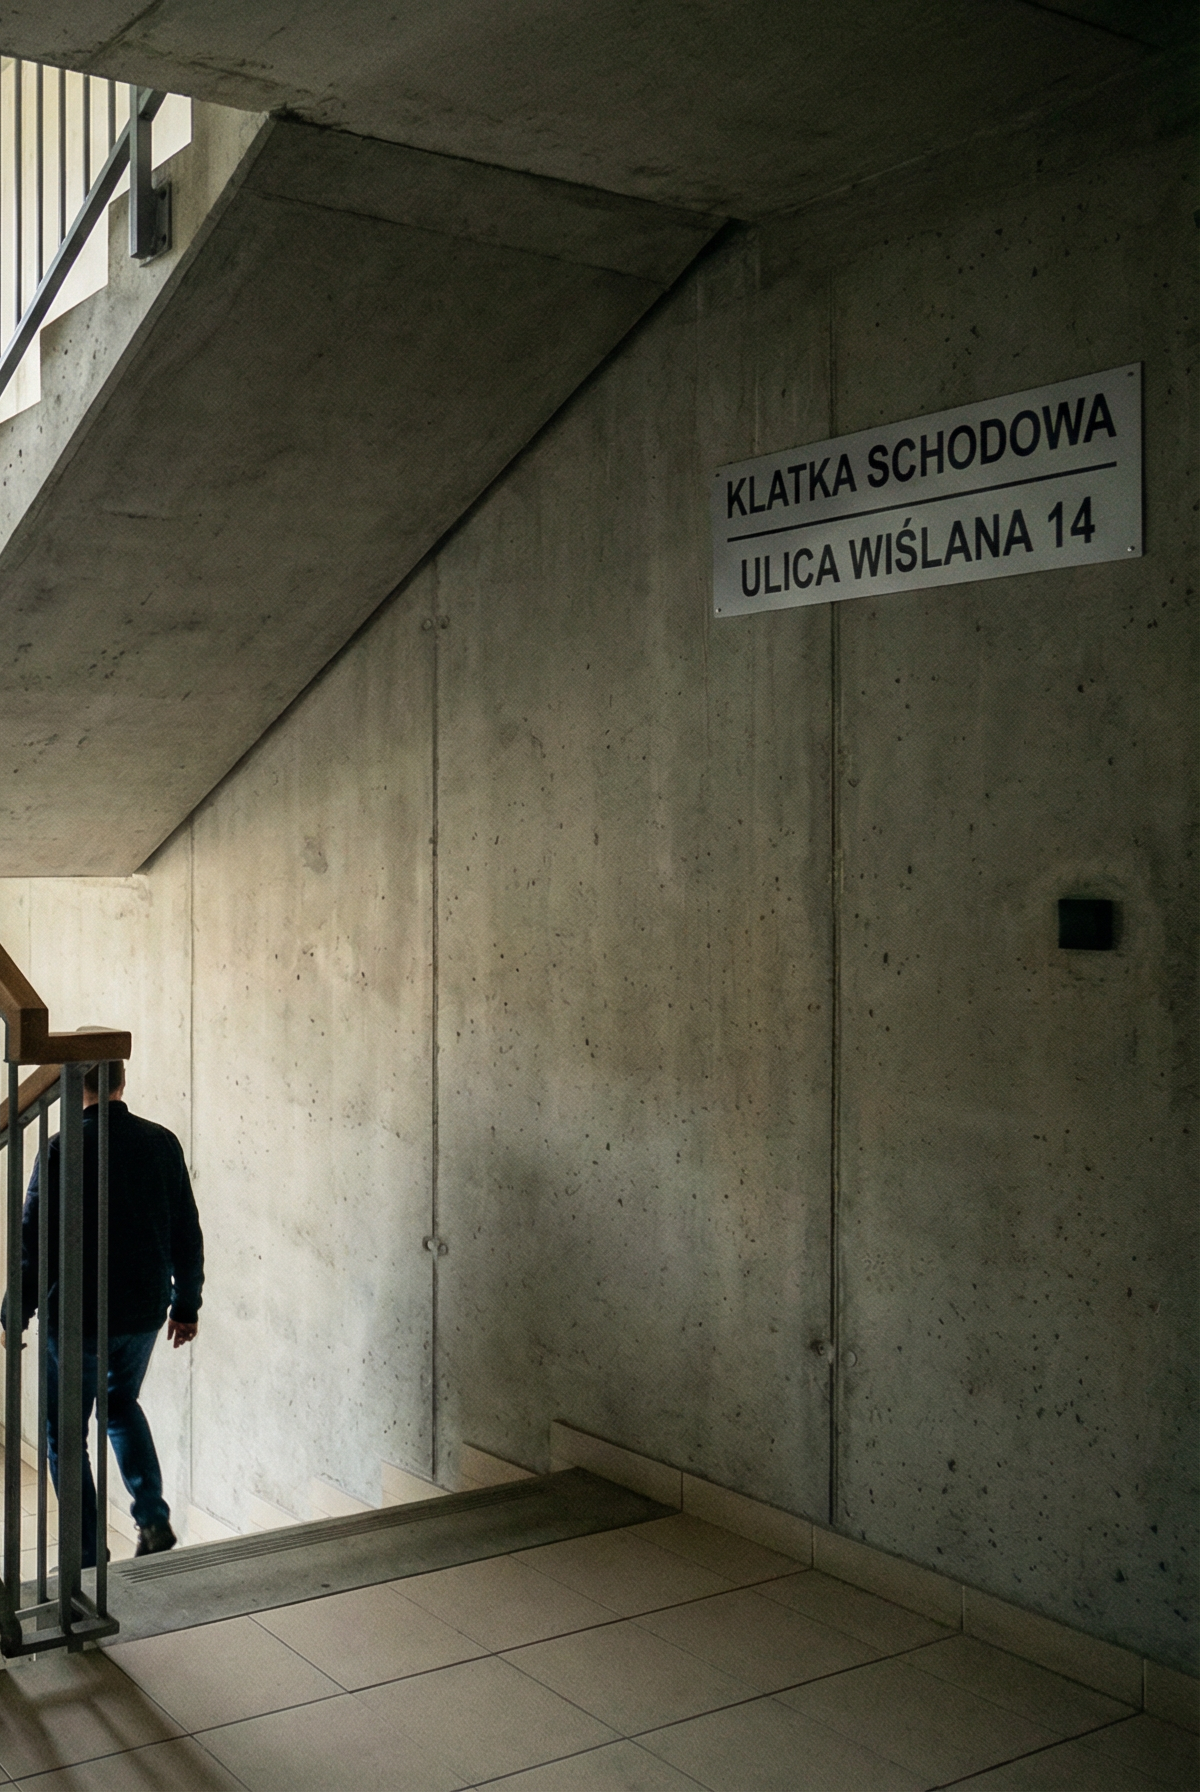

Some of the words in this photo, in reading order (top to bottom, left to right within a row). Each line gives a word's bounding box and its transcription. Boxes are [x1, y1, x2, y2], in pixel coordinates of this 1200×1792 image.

[727, 453, 857, 518] KLATKA
[867, 393, 1116, 488] SCHODOWA
[741, 543, 840, 597] ULICA
[848, 508, 1034, 580] WIŚLANA
[1047, 496, 1095, 548] 14
